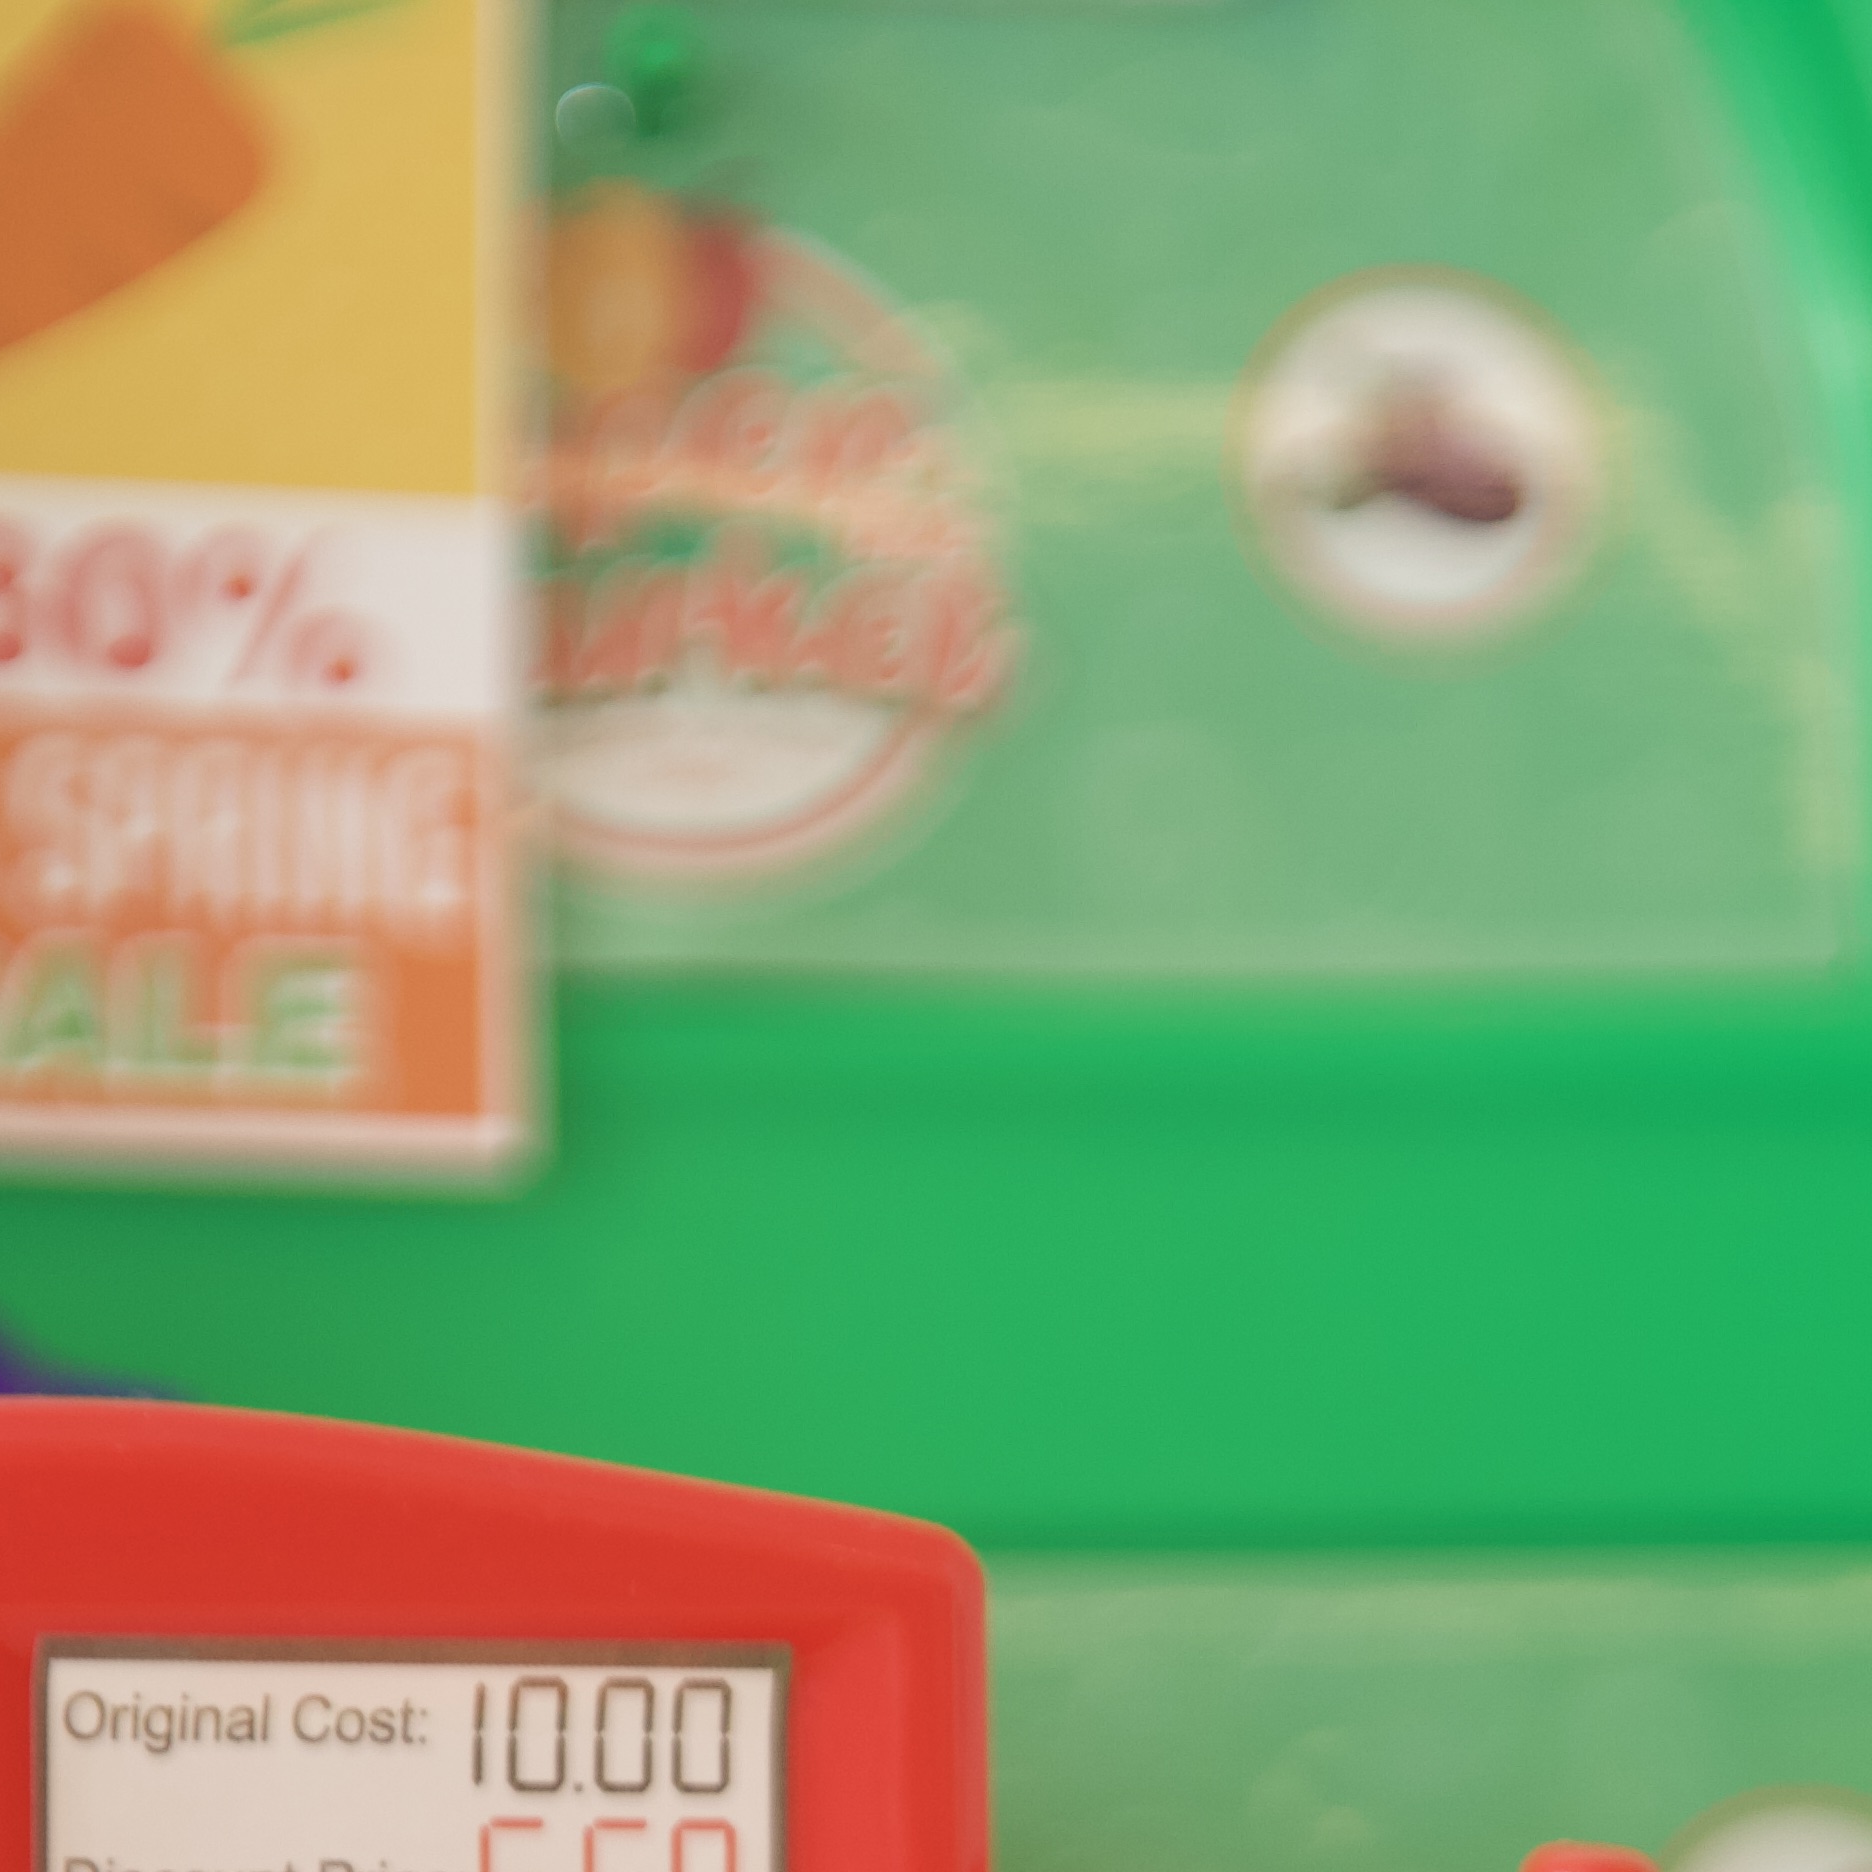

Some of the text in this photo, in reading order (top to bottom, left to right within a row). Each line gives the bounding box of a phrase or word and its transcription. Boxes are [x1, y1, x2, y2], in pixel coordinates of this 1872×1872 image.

[3, 730, 478, 935] SPRING
[62, 1674, 732, 1795] Original Cost: 10.00
